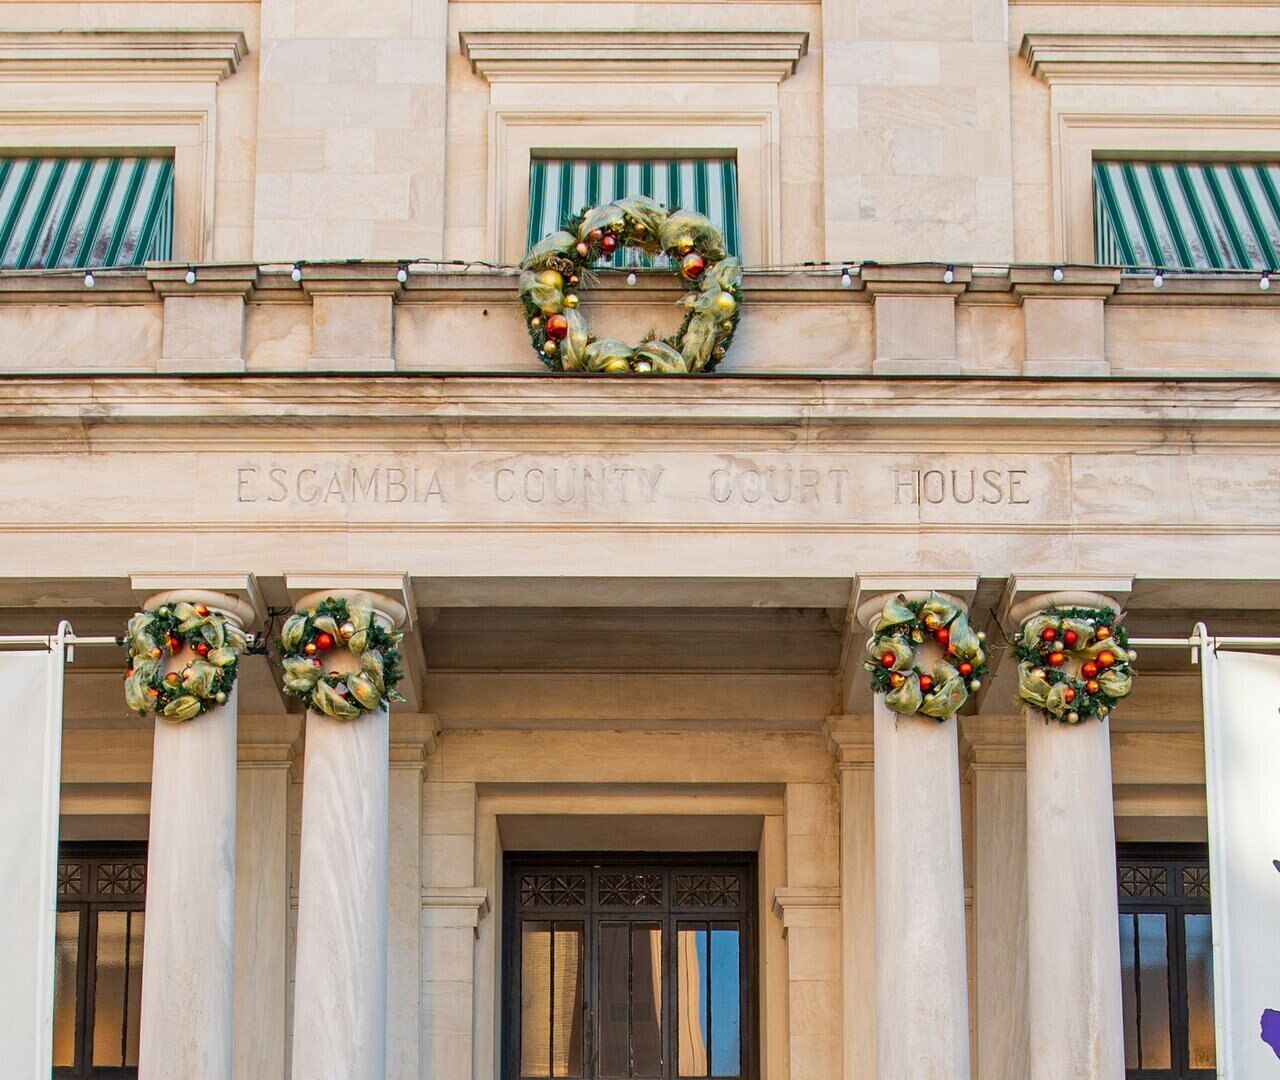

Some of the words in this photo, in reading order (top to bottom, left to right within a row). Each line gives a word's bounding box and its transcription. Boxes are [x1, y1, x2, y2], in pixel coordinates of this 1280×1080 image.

[235, 466, 447, 504] ESCAMBIA
[493, 467, 665, 505] COUNTY
[707, 468, 850, 505] COURT
[892, 468, 1031, 505] HOUSE
